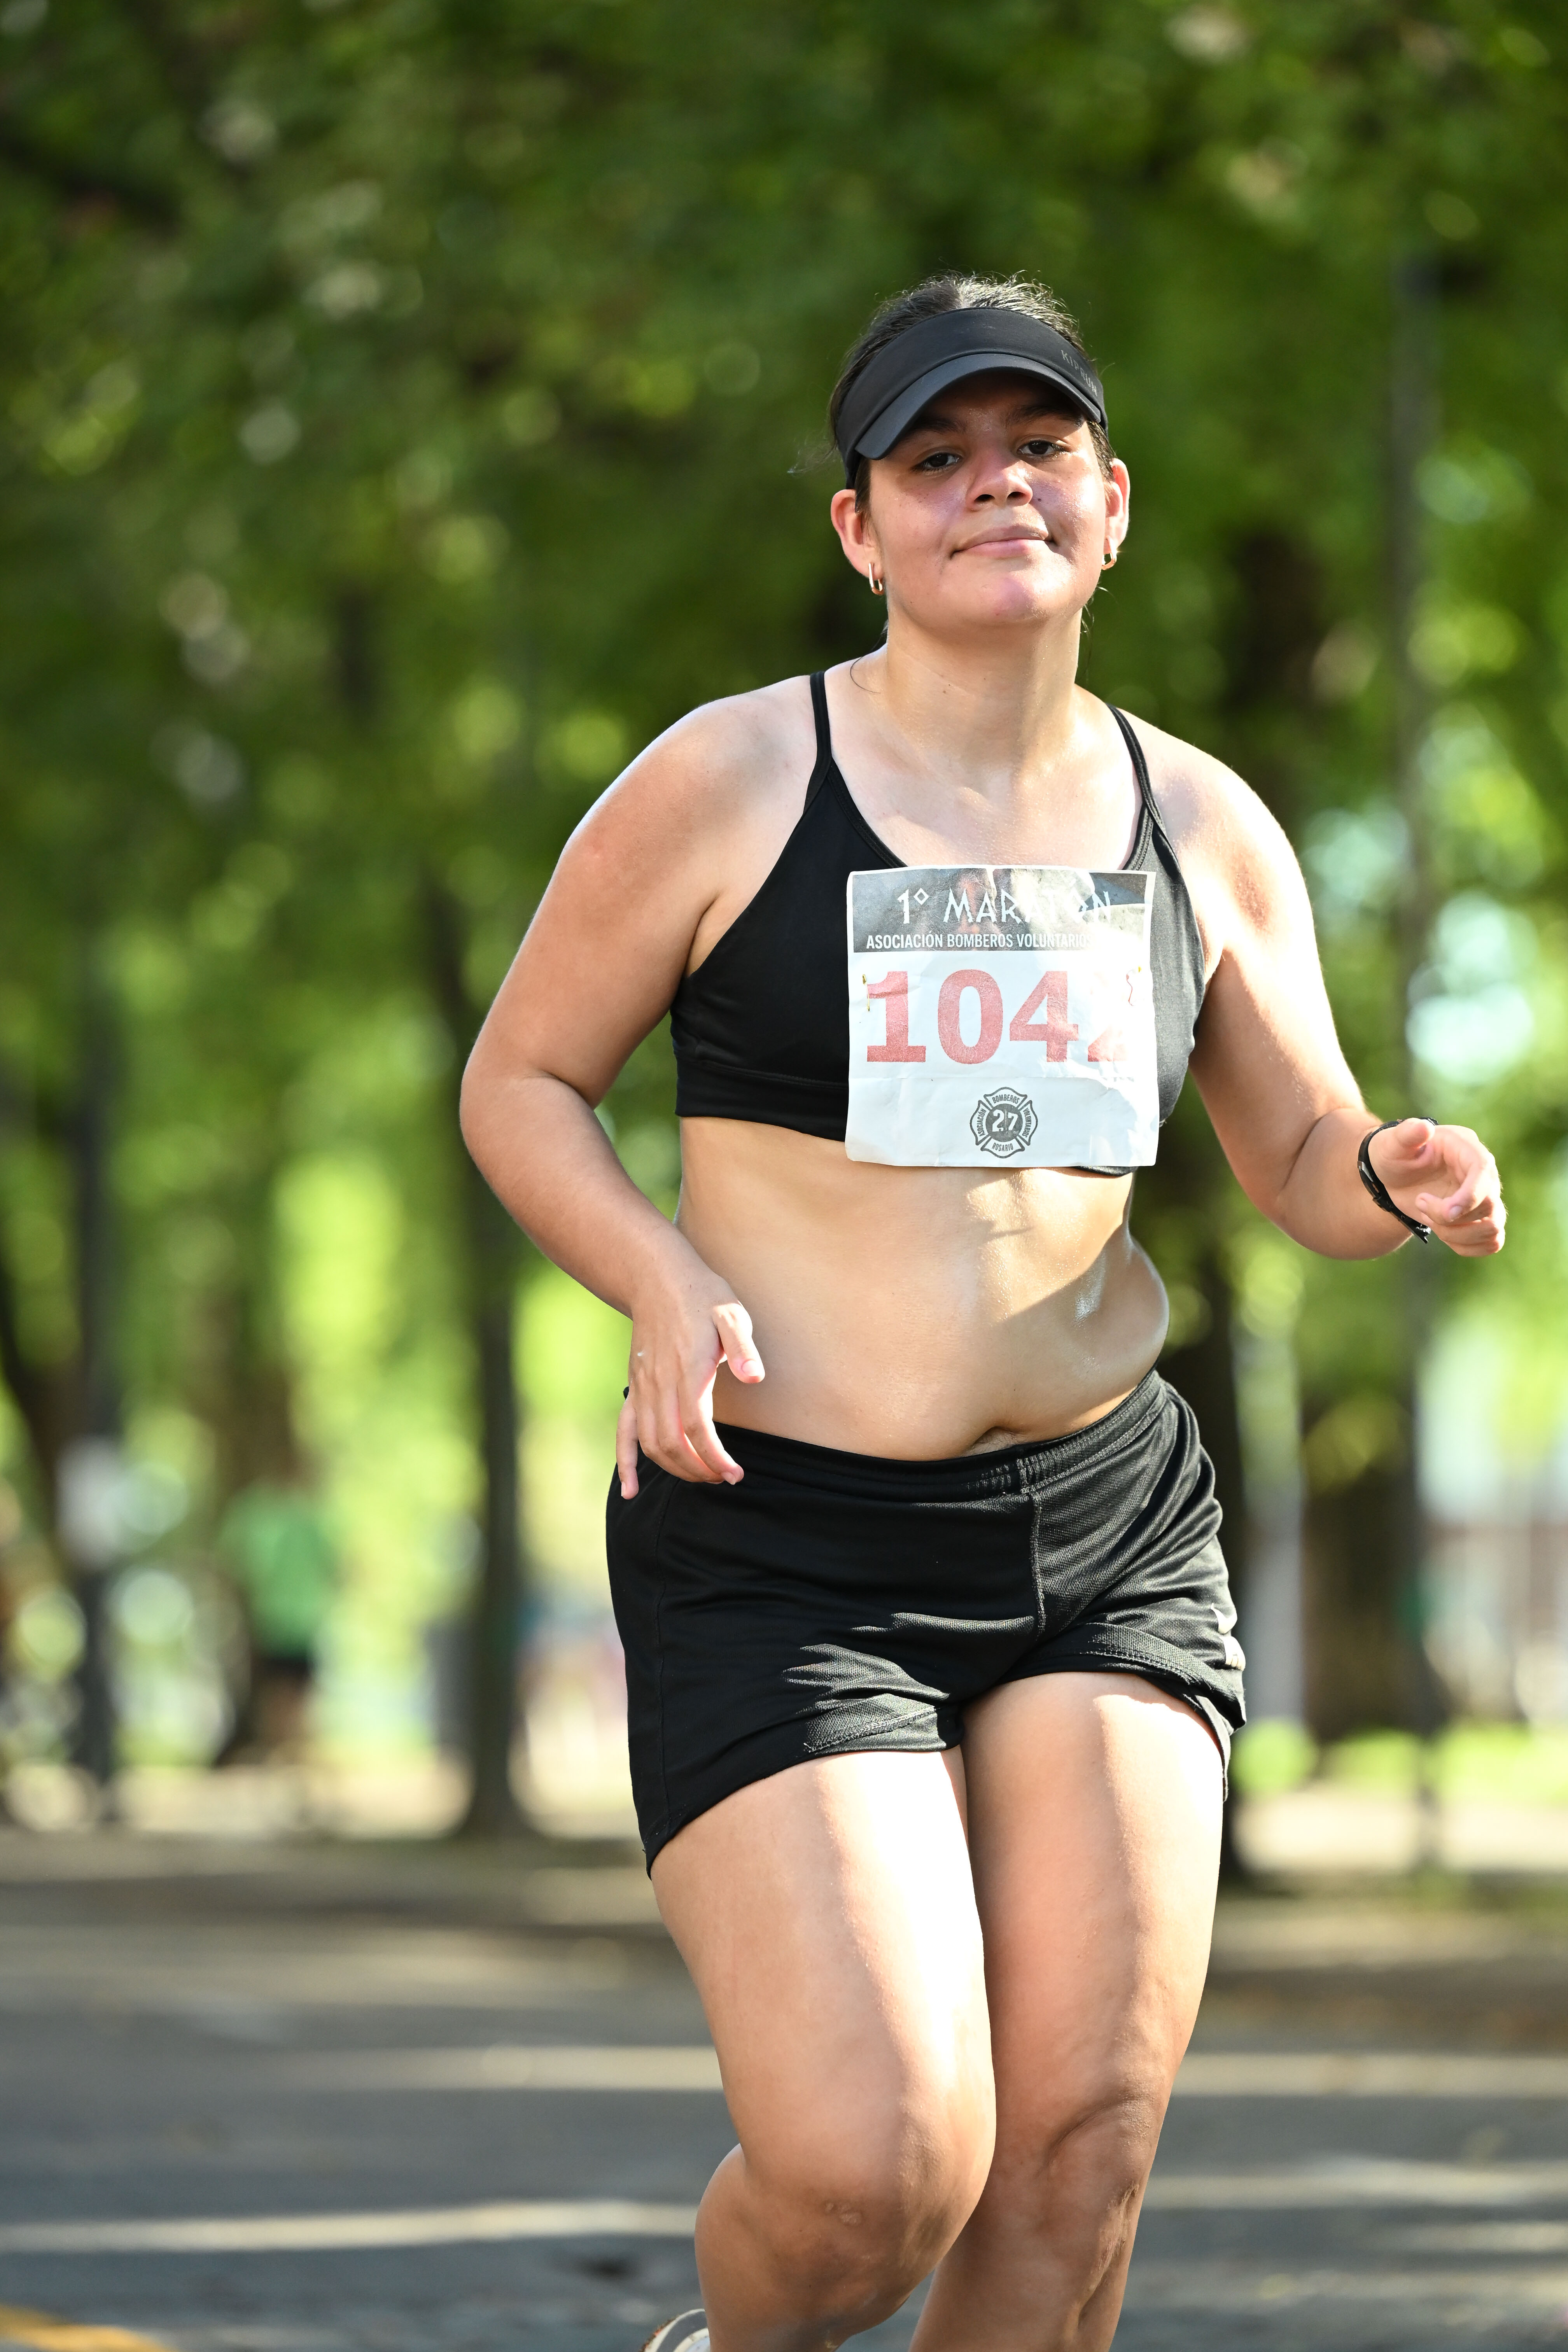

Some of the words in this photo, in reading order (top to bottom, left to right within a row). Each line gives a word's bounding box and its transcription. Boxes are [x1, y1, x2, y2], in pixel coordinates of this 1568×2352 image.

[1061, 350, 1097, 396] KIPRUN
[897, 887, 929, 924] 1°
[943, 879, 1111, 924] MARATÓN
[866, 931, 943, 949] ASOCIACIÓN
[947, 934, 1013, 948] BOMBEROS
[1017, 933, 1092, 948] VOLUNTARIOS
[992, 1094, 1020, 1104] BOMBEROS
[976, 1108, 987, 1137] ASOCIACIÓN
[1022, 1108, 1032, 1138] VOLUNTARIOS
[992, 1142, 1014, 1152] ROSARIO
